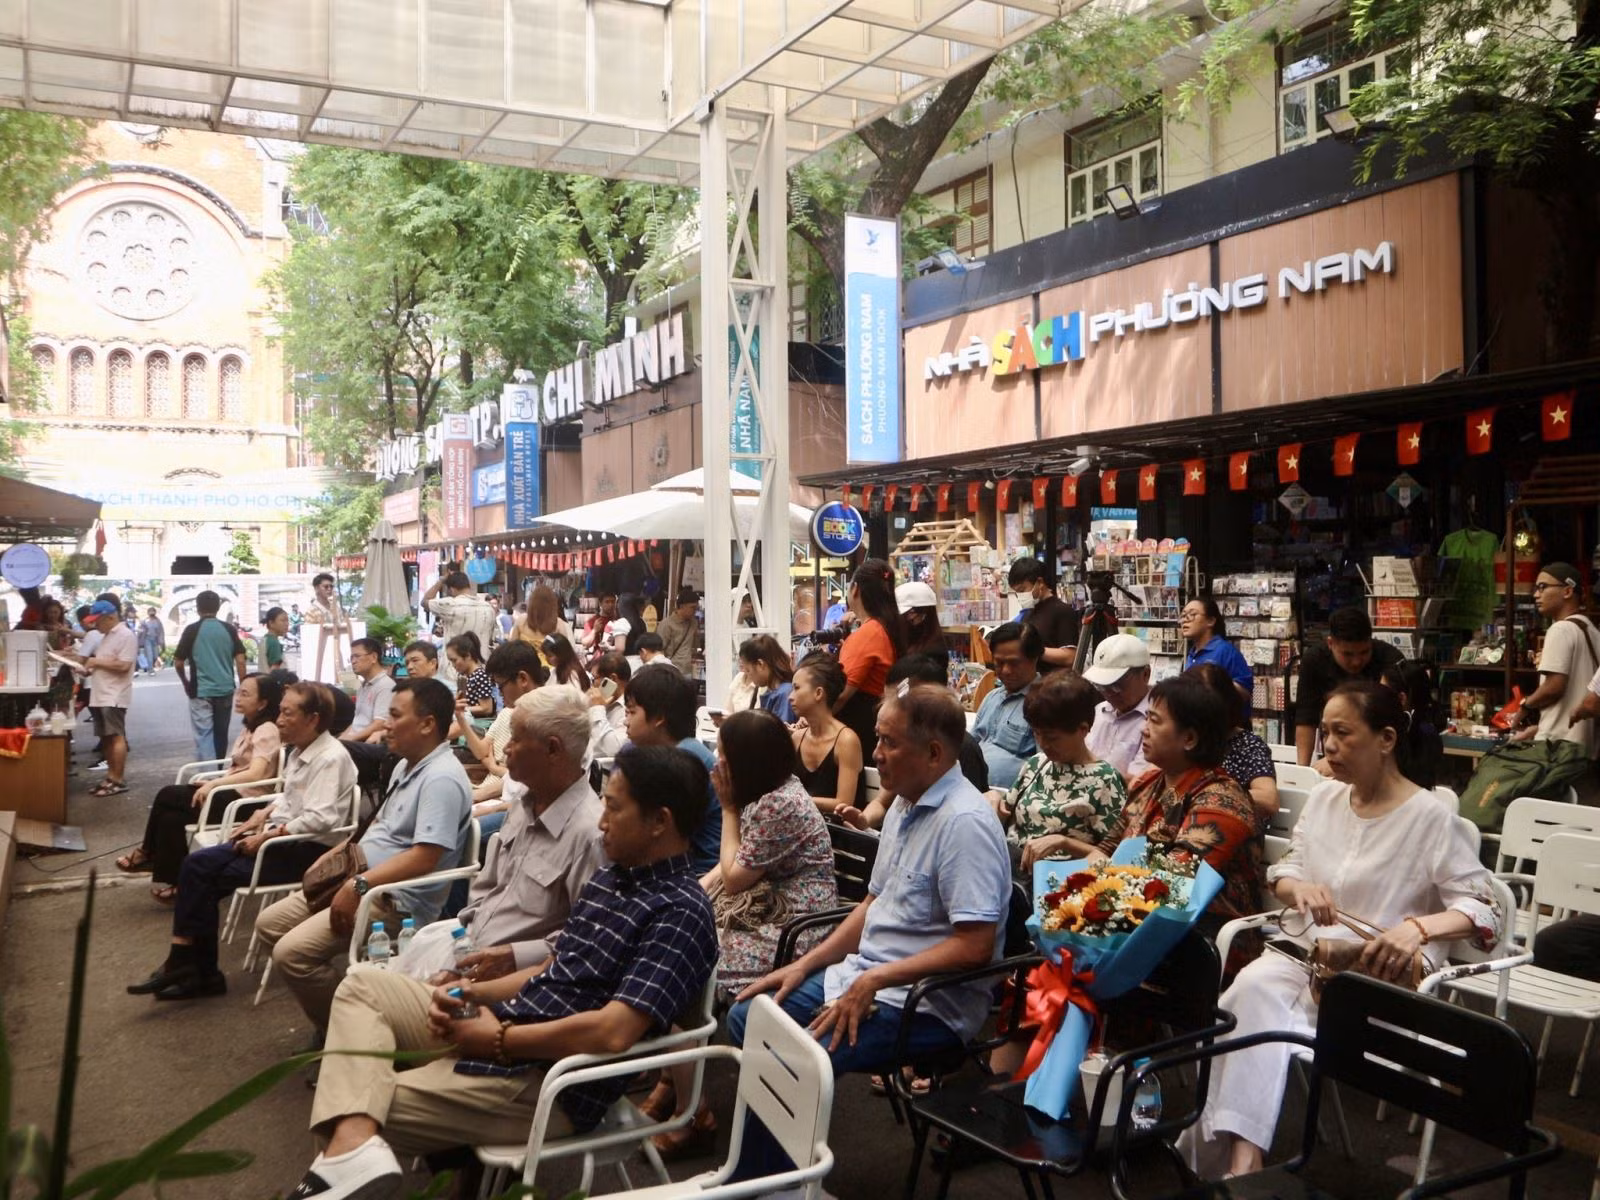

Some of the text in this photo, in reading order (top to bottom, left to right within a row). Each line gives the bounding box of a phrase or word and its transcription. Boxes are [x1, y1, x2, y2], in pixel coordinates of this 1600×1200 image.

[860, 293, 873, 330] NAM
[877, 308, 886, 343] BOOK
[924, 240, 1395, 379] NHÀ SÁCH PHƯƠNG NAM
[594, 312, 686, 406] MINH
[877, 347, 886, 376] NAM
[509, 429, 525, 525] NHÀ XUẤT BẢN TRẺ
[823, 520, 856, 534] BOOK
[823, 532, 856, 541] STORE
